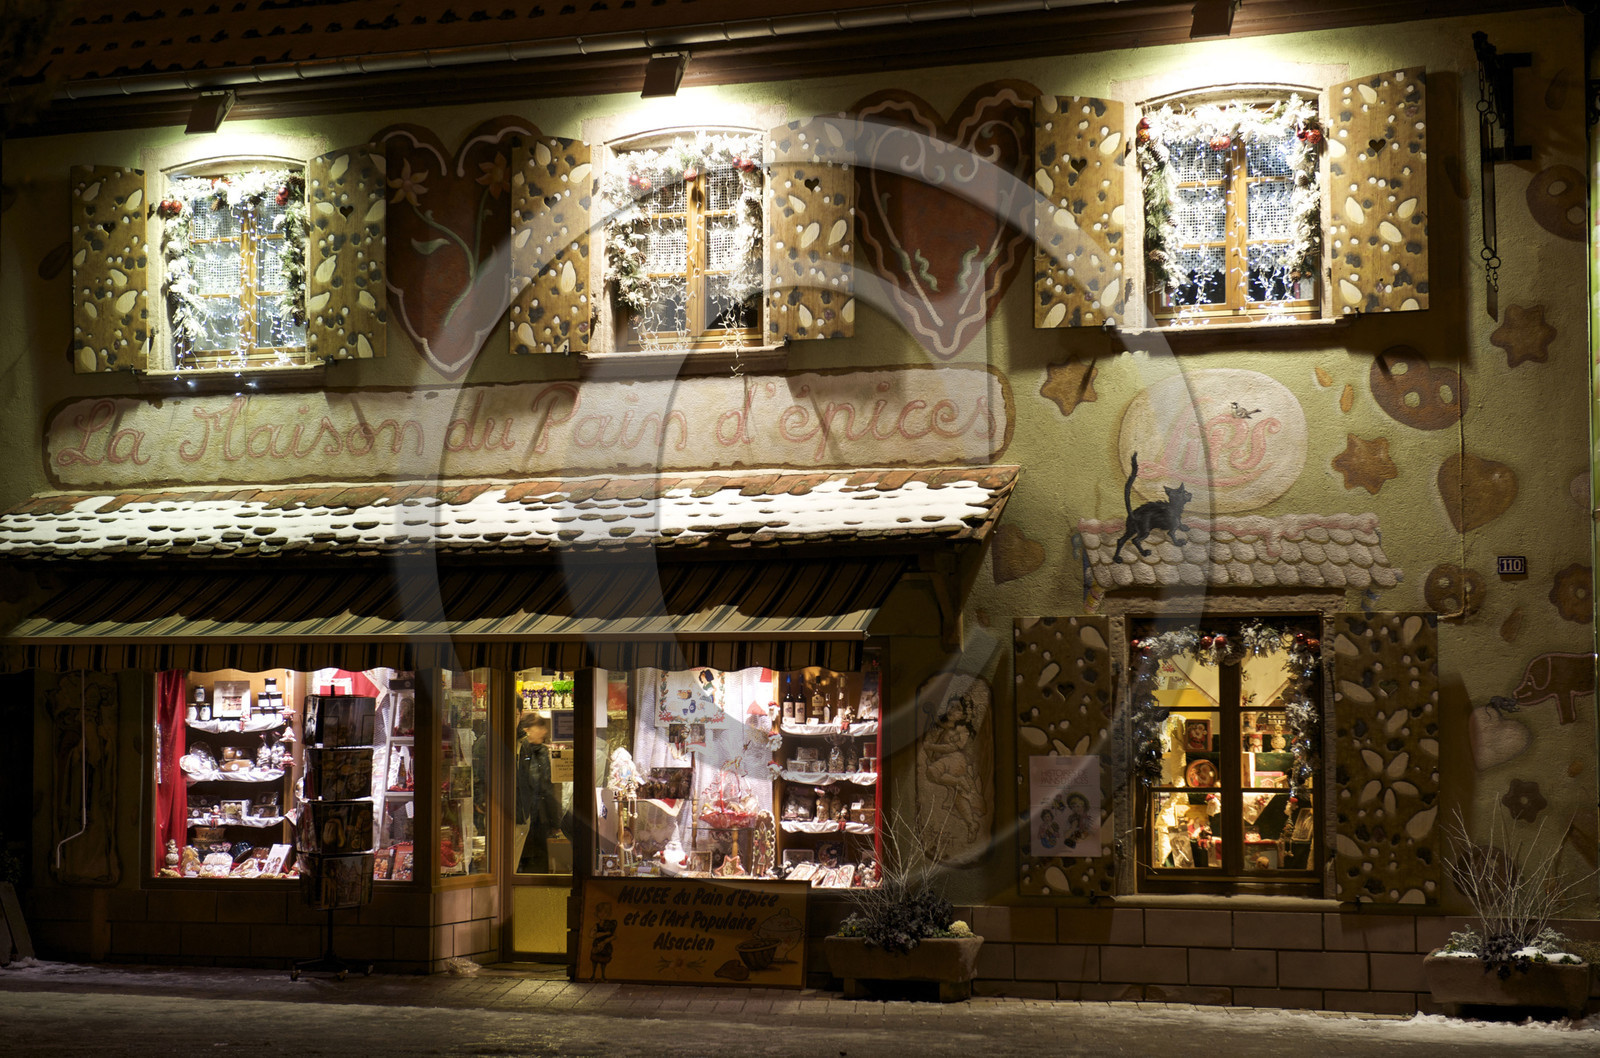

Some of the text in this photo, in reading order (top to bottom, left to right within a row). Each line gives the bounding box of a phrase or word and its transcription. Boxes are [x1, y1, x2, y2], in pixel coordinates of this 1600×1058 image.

[57, 377, 999, 465] La Maison du Pain d'épices
[1501, 559, 1522, 571] 110
[617, 885, 780, 909] MUSEE du Pain d'Epice
[624, 909, 757, 932] et de l'Art Populaire
[653, 931, 715, 951] Alsacien
